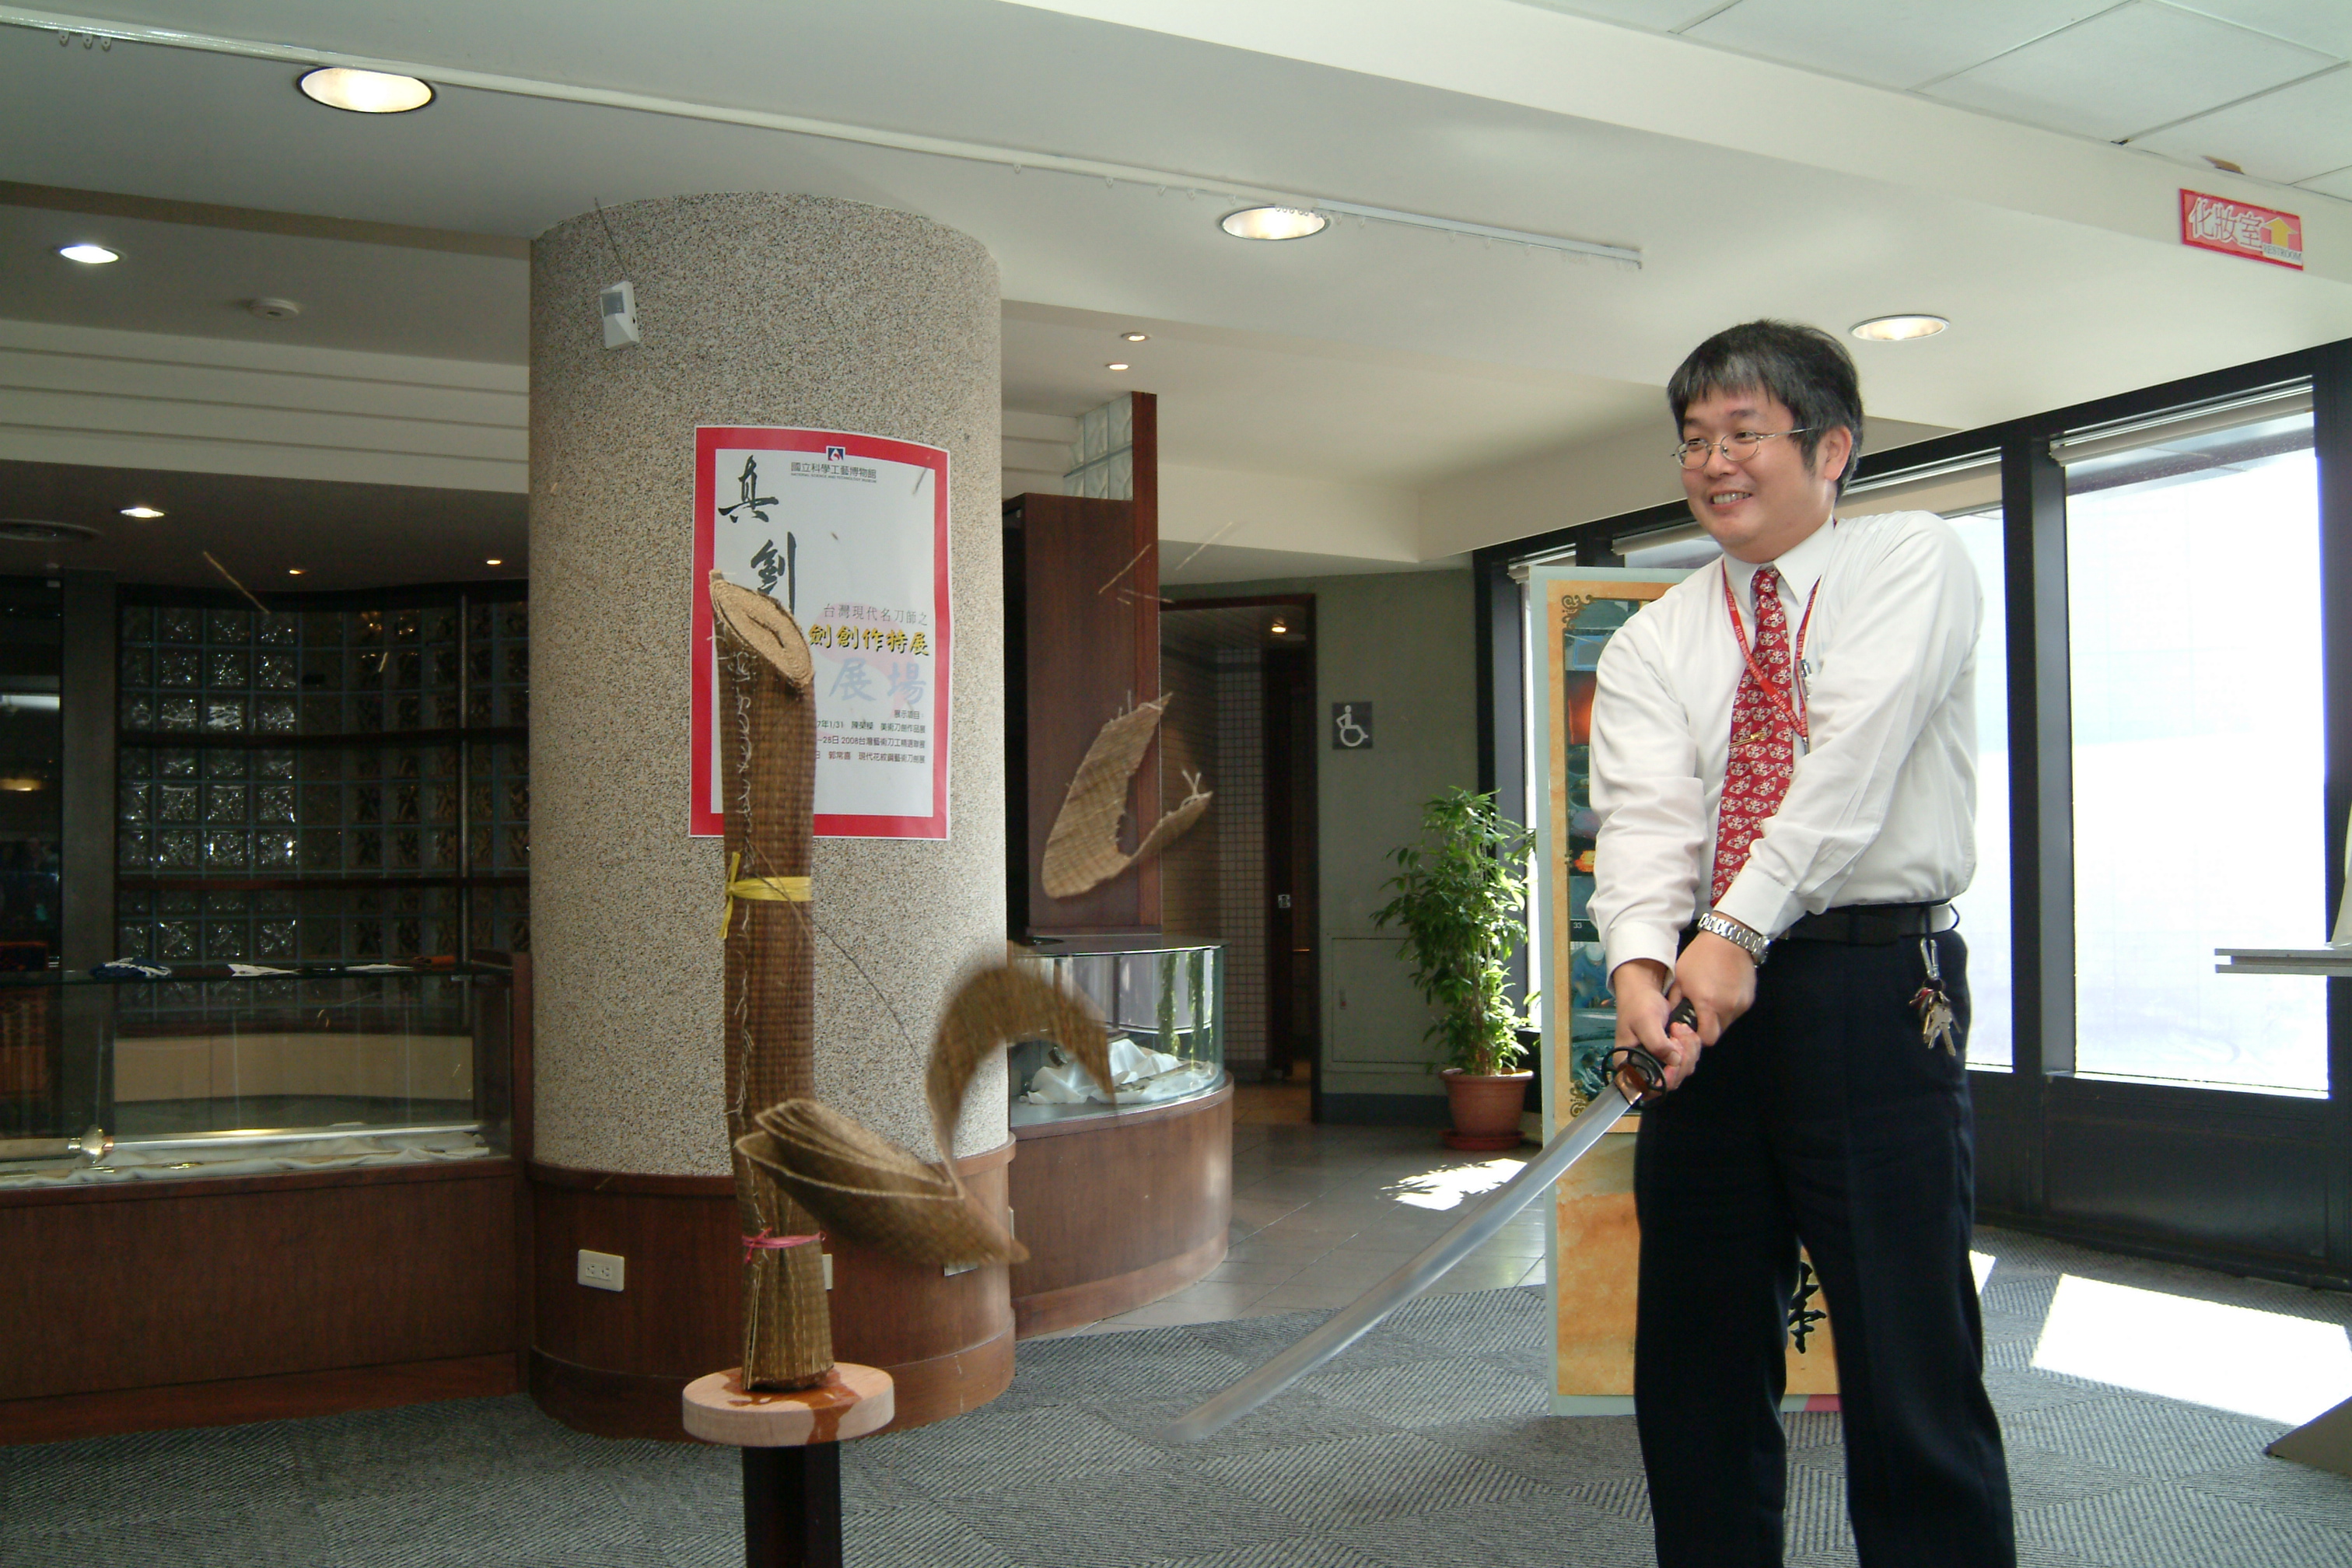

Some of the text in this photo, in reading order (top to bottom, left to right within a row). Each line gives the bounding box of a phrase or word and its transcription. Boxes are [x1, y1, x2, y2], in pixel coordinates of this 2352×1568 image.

[2263, 245, 2302, 262] RESTROOM
[790, 462, 877, 479] 國立科學工藝博物館
[824, 603, 928, 626] 台灣現代名刀師之
[828, 657, 926, 705] 展場
[1771, 693, 1787, 711] NSTM
